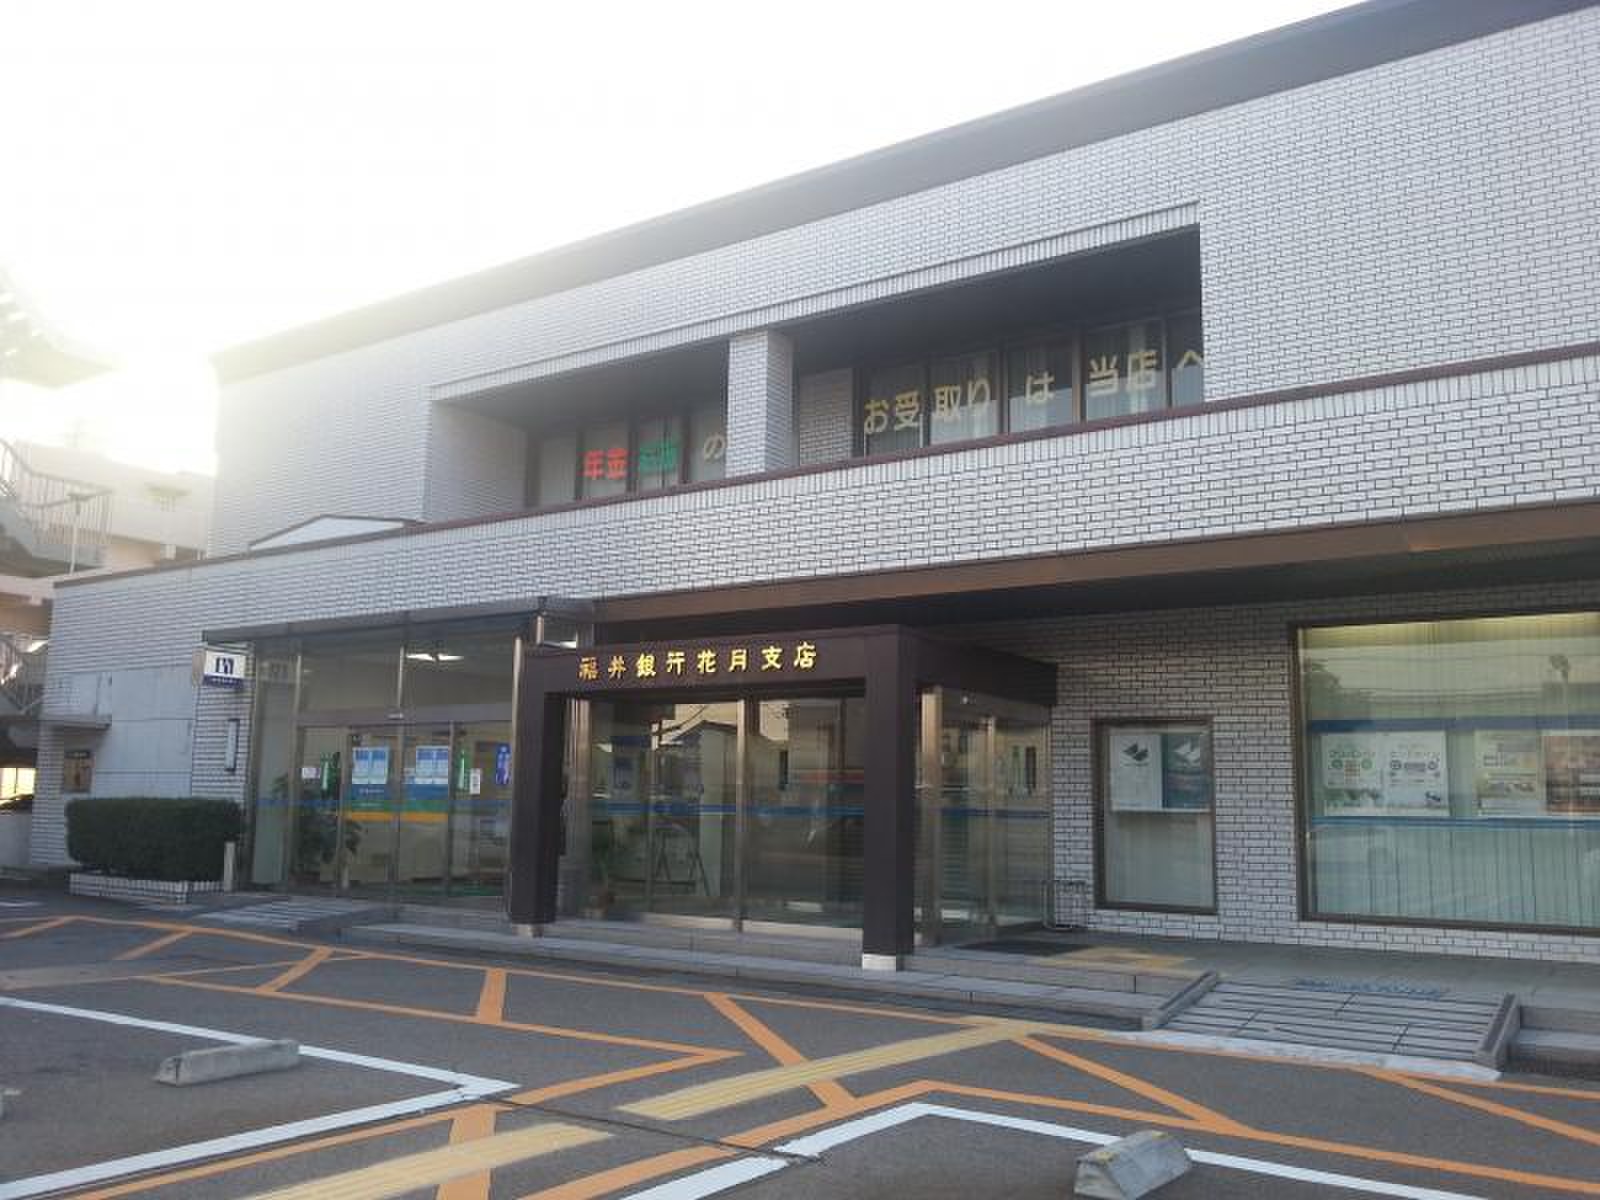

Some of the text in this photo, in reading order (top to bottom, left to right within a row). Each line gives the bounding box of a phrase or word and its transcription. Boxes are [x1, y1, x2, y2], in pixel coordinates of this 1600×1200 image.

[579, 641, 818, 680] 福井銀行花月支店
